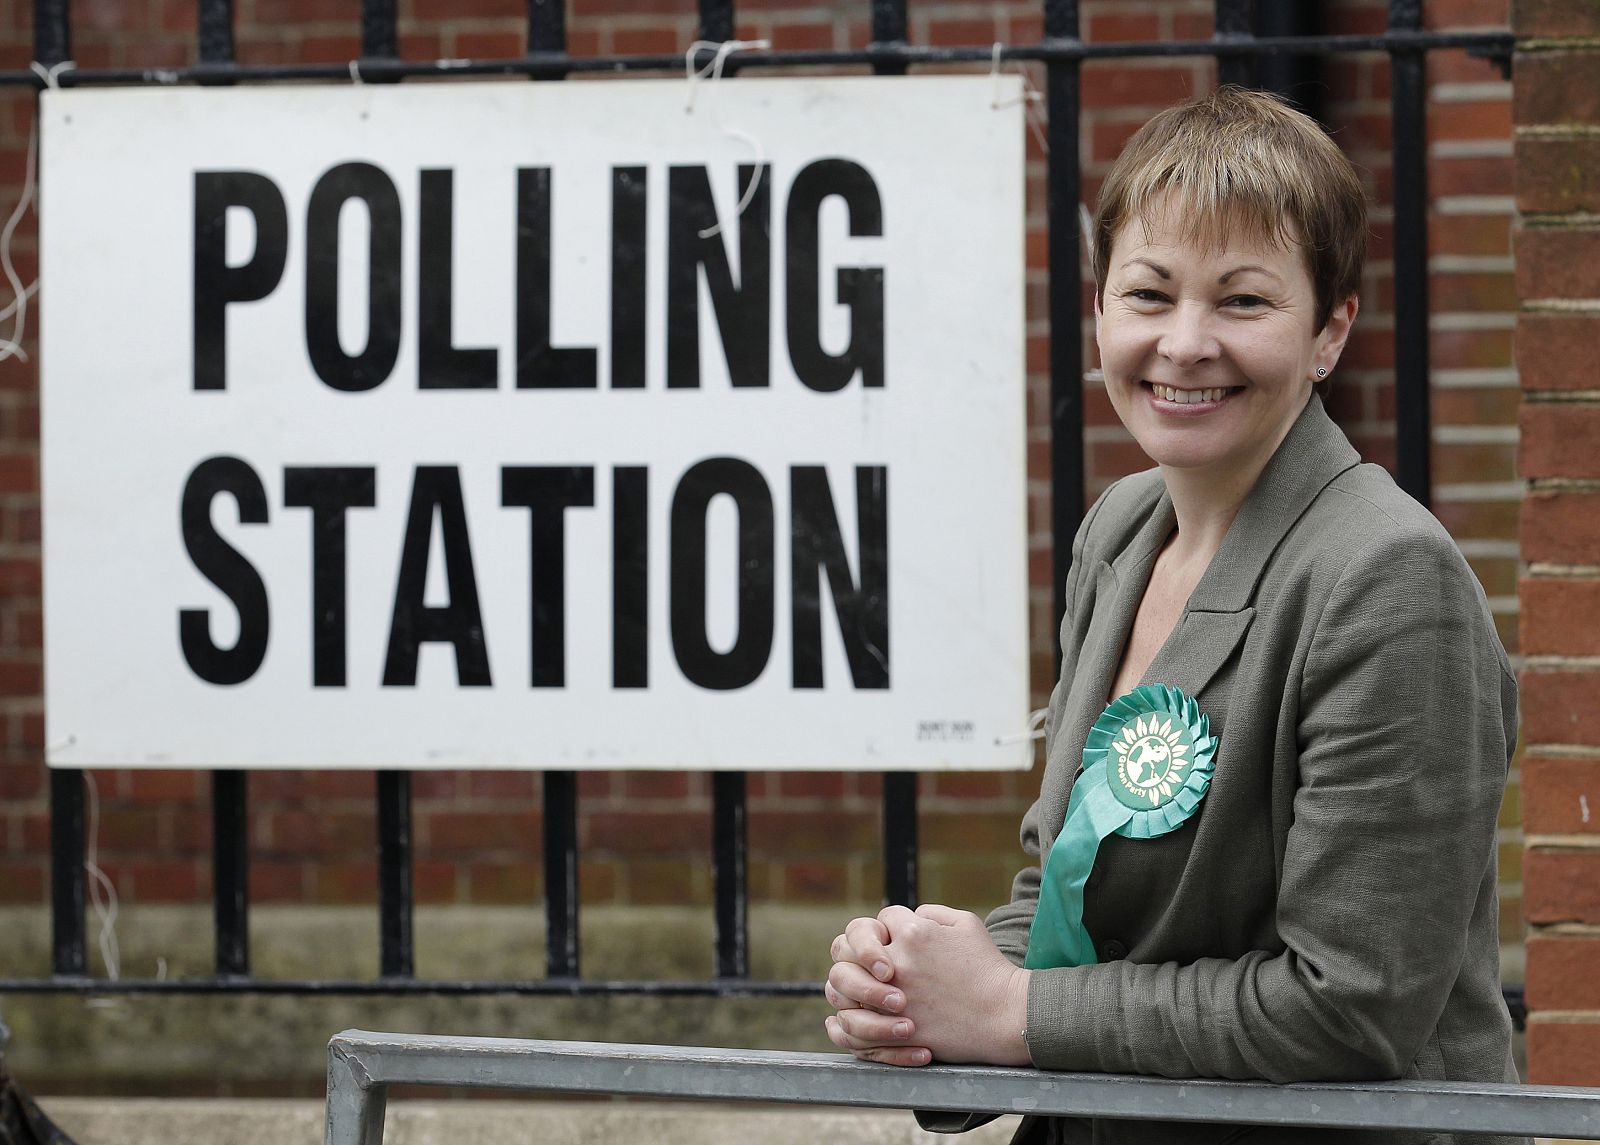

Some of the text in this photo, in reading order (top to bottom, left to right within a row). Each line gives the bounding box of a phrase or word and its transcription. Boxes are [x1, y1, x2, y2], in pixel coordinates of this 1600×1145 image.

[194, 159, 885, 392] POLLING
[180, 456, 890, 690] STATION
[1117, 755, 1147, 798] Green Party
